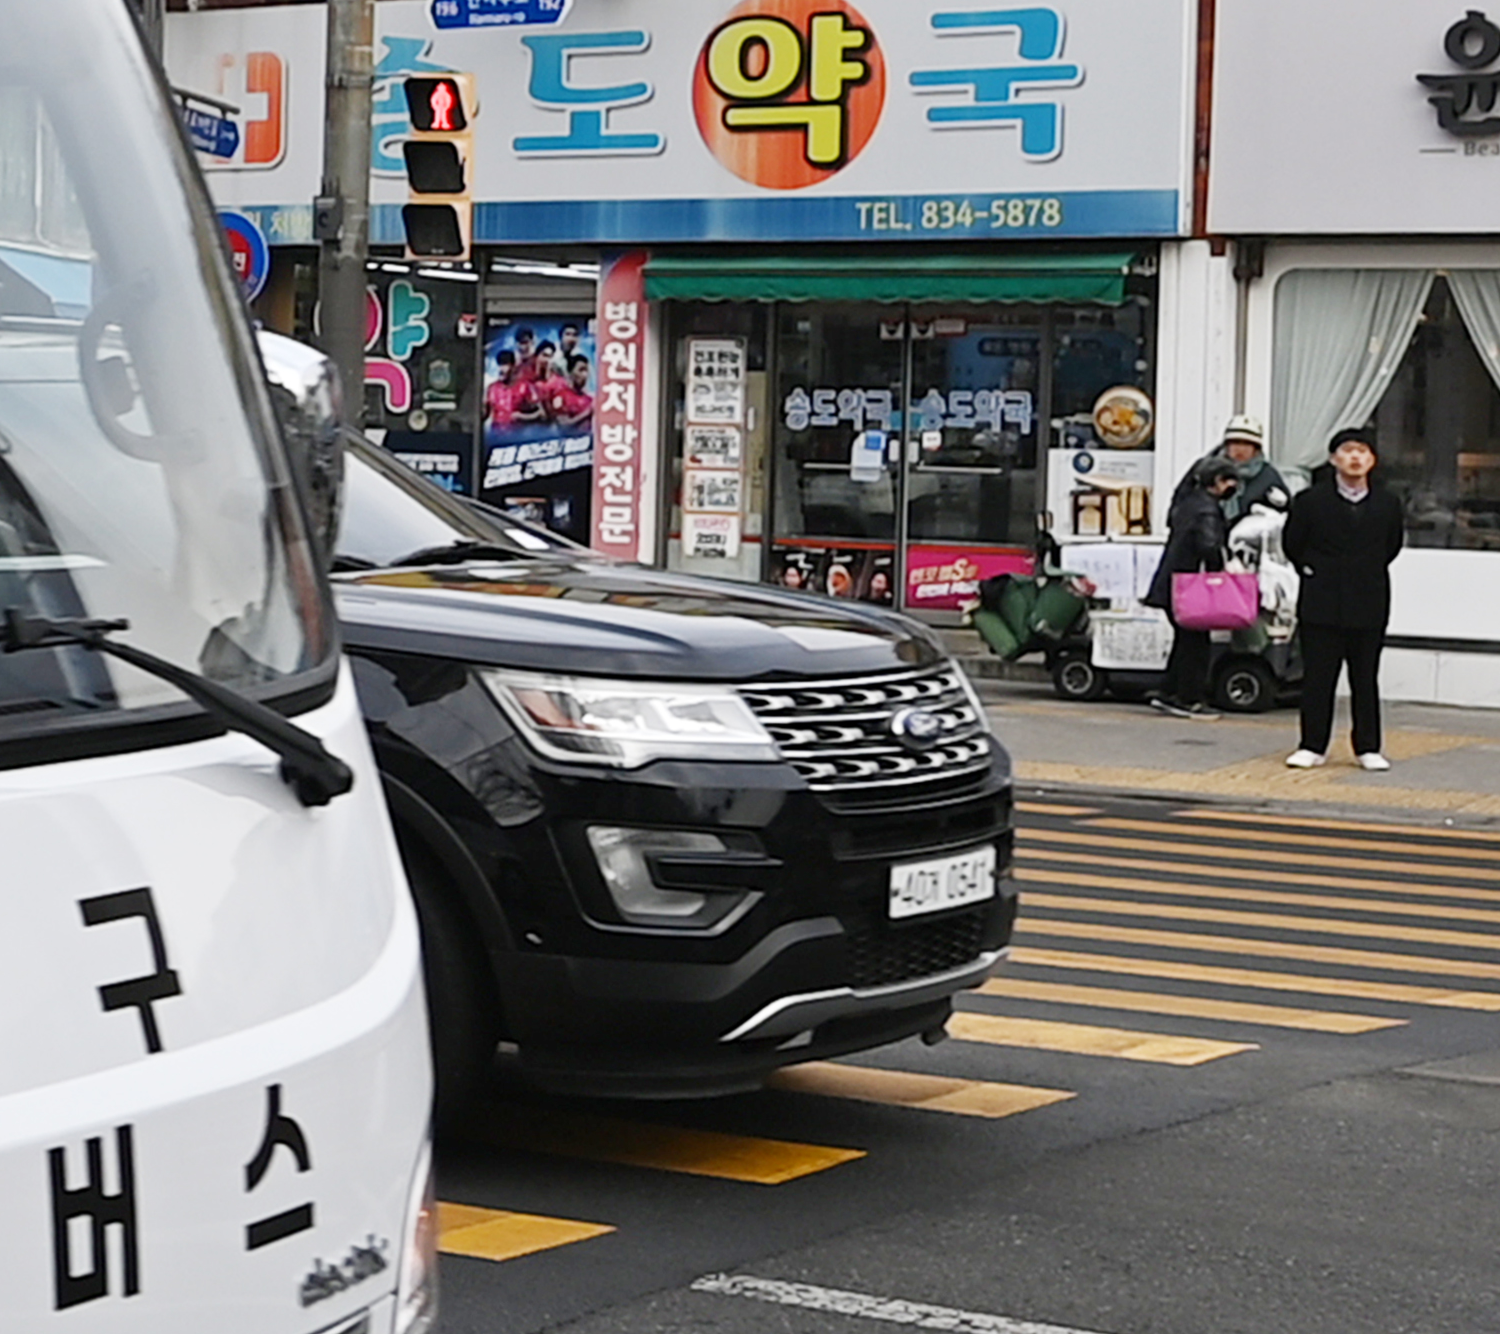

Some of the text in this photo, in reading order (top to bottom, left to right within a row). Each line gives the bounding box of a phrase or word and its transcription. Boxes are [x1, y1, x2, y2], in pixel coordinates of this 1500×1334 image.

[855, 198, 1063, 231] TEL. 834-5878
[599, 302, 639, 545] 병원처방전문
[785, 387, 892, 431] 송도약국
[922, 388, 1032, 434] 송도약국
